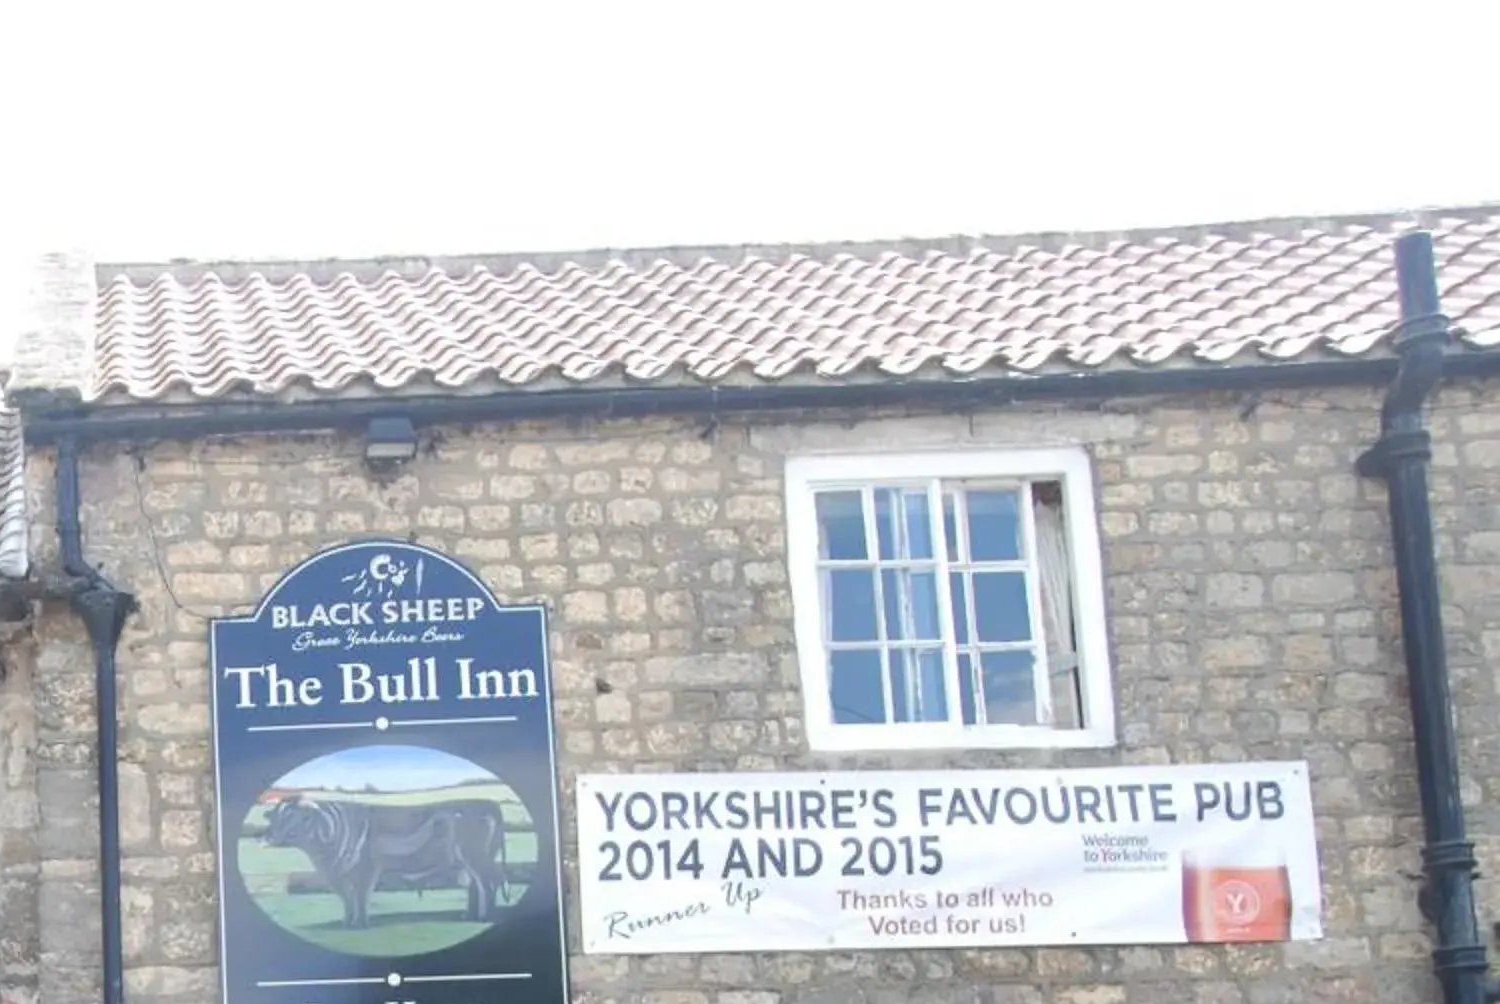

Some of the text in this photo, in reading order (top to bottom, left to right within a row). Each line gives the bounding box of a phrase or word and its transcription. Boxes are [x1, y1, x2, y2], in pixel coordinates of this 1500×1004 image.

[271, 598, 485, 629] BLACK SHEEP
[344, 628, 417, 650] Yorkshire
[224, 656, 540, 708] The Bull Inn
[595, 781, 1285, 832] YORKSHIRE'S FAVOURITE PUB
[1082, 834, 1148, 847] Welcome
[598, 836, 943, 881] 2014 AND 2015
[604, 881, 764, 939] Runner Up
[838, 886, 1053, 910] Thanks to all who
[868, 914, 1026, 935] Voted for us!
